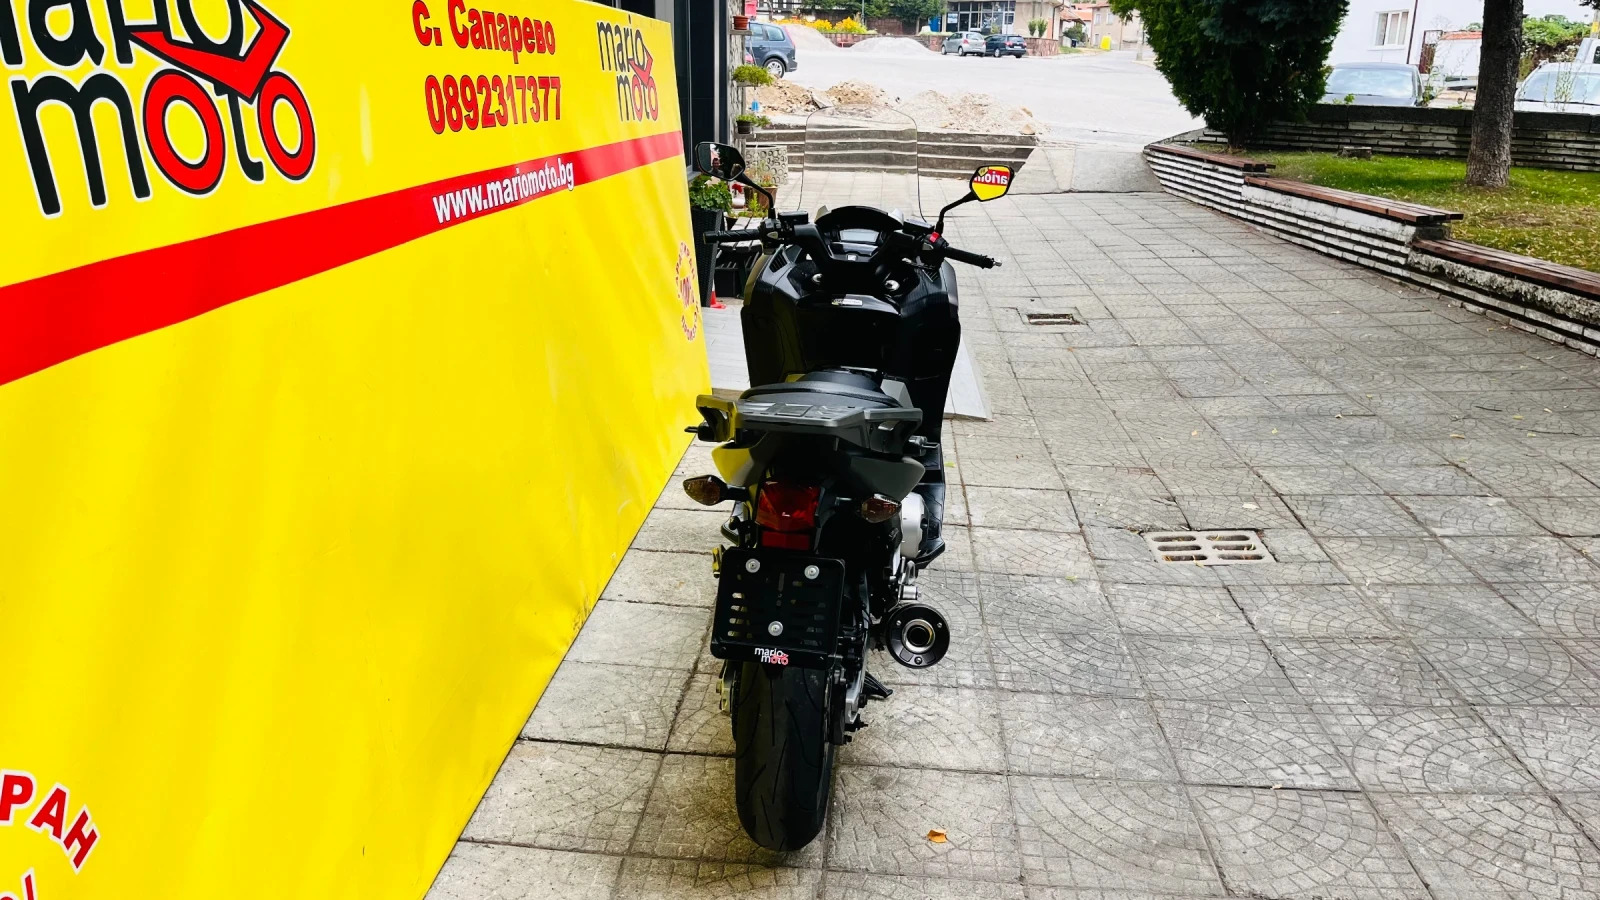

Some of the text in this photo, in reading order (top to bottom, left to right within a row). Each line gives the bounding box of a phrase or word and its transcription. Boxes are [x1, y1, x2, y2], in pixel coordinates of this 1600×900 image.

[447, 0, 556, 64] Сапарево
[596, 15, 647, 72] mario
[424, 74, 561, 135] 0892317377
[616, 73, 658, 122] moto
[10, 68, 316, 216] moto
[432, 157, 574, 224] www.mariomoto.bg
[754, 647, 786, 657] mario
[760, 655, 789, 666] moto
